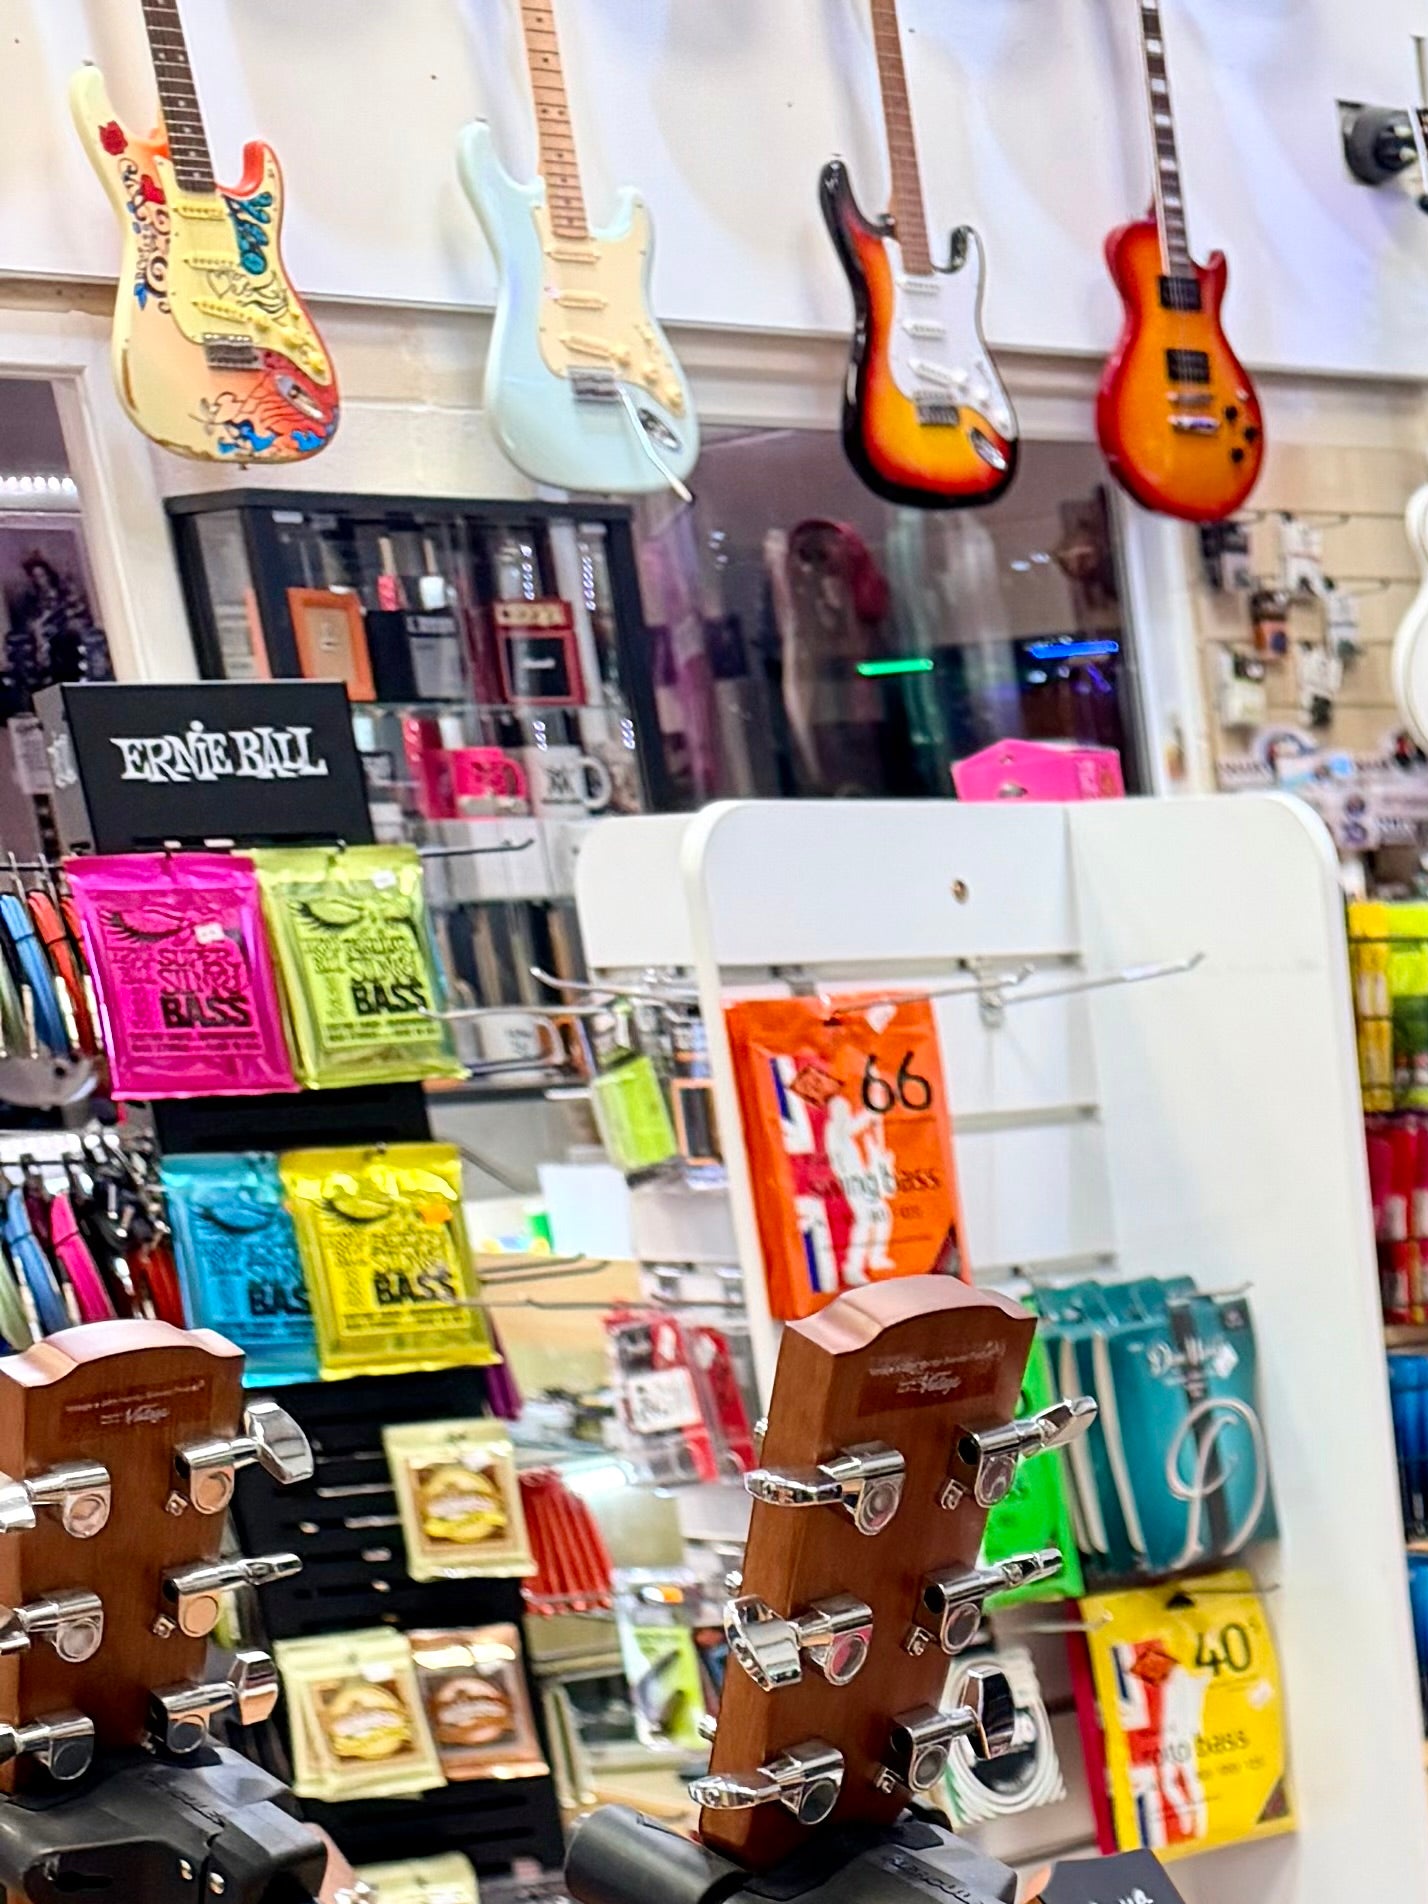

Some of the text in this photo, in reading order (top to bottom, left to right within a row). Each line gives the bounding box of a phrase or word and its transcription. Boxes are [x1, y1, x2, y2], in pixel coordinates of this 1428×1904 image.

[109, 720, 328, 783] ERNIE BALL
[161, 996, 253, 1028] BASS
[352, 978, 427, 1016] BASS
[862, 1050, 933, 1114] 66
[249, 1278, 311, 1316] BAS
[374, 1269, 457, 1306] BASS
[1195, 1623, 1252, 1677] 40
